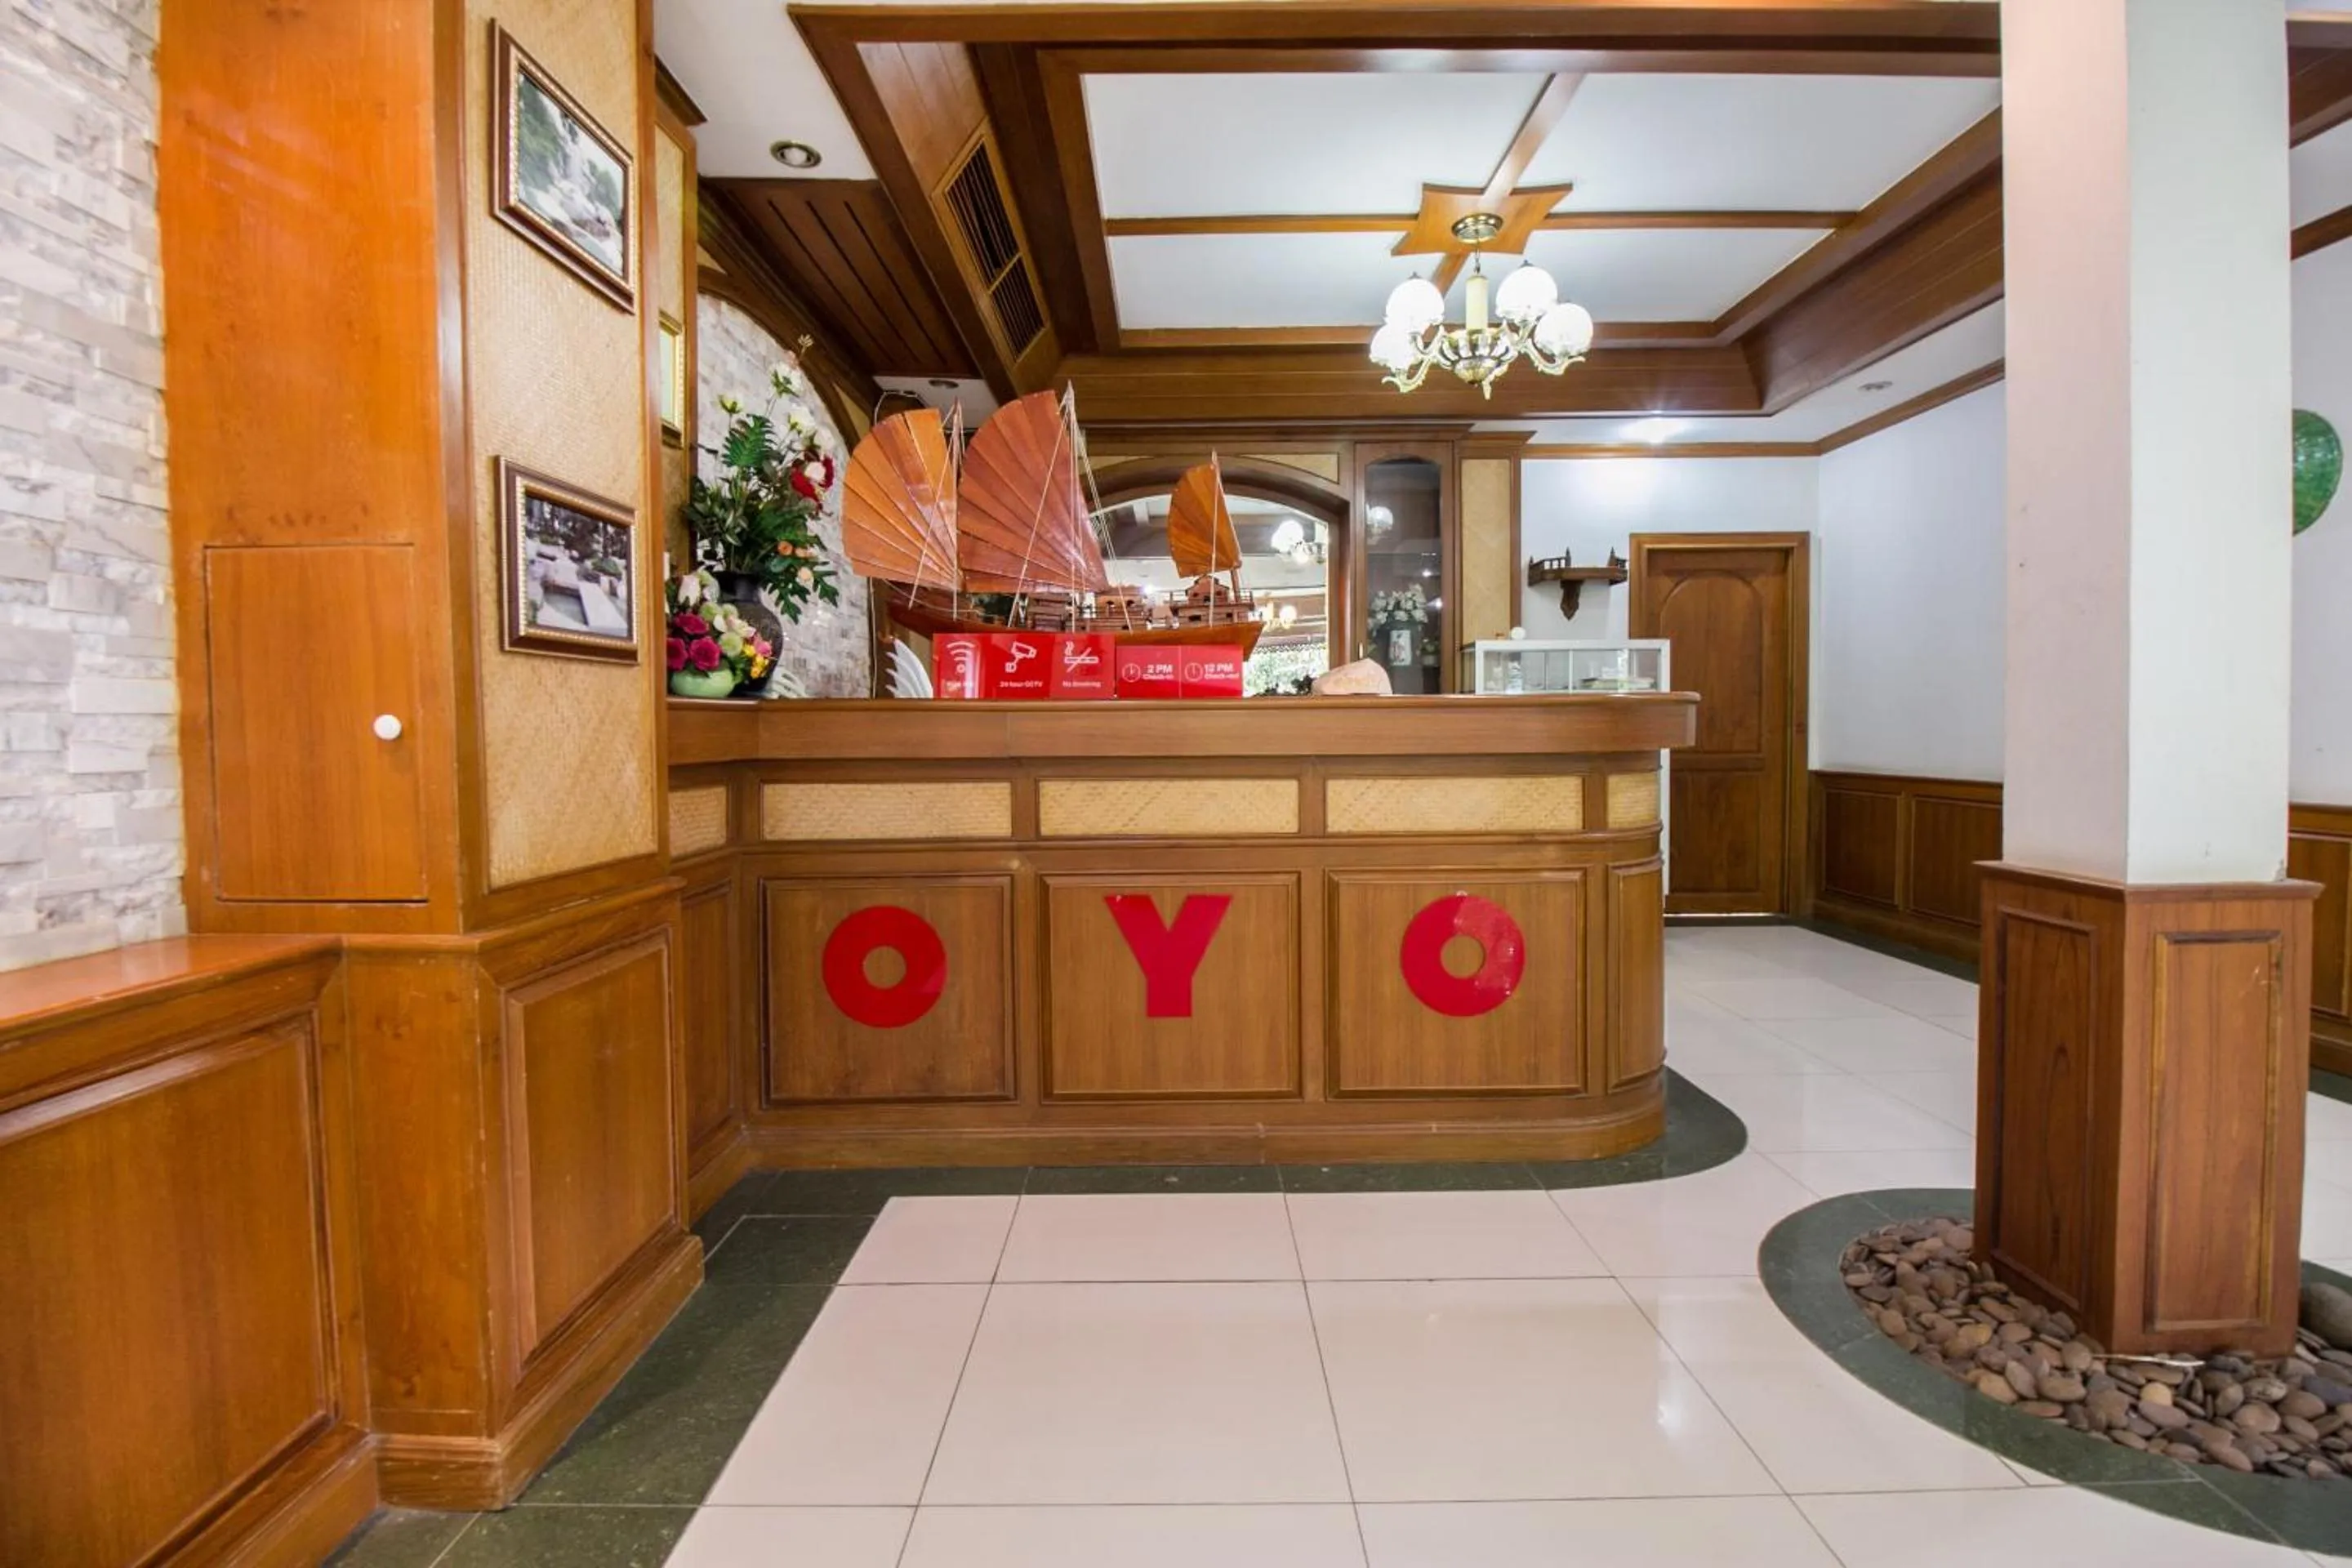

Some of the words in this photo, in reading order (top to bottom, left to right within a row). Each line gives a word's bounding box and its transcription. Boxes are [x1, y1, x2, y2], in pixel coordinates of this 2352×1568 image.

[1147, 664, 1155, 674] 2
[1156, 664, 1174, 674] PM
[1204, 663, 1214, 673] 12
[1216, 663, 1234, 673] PM
